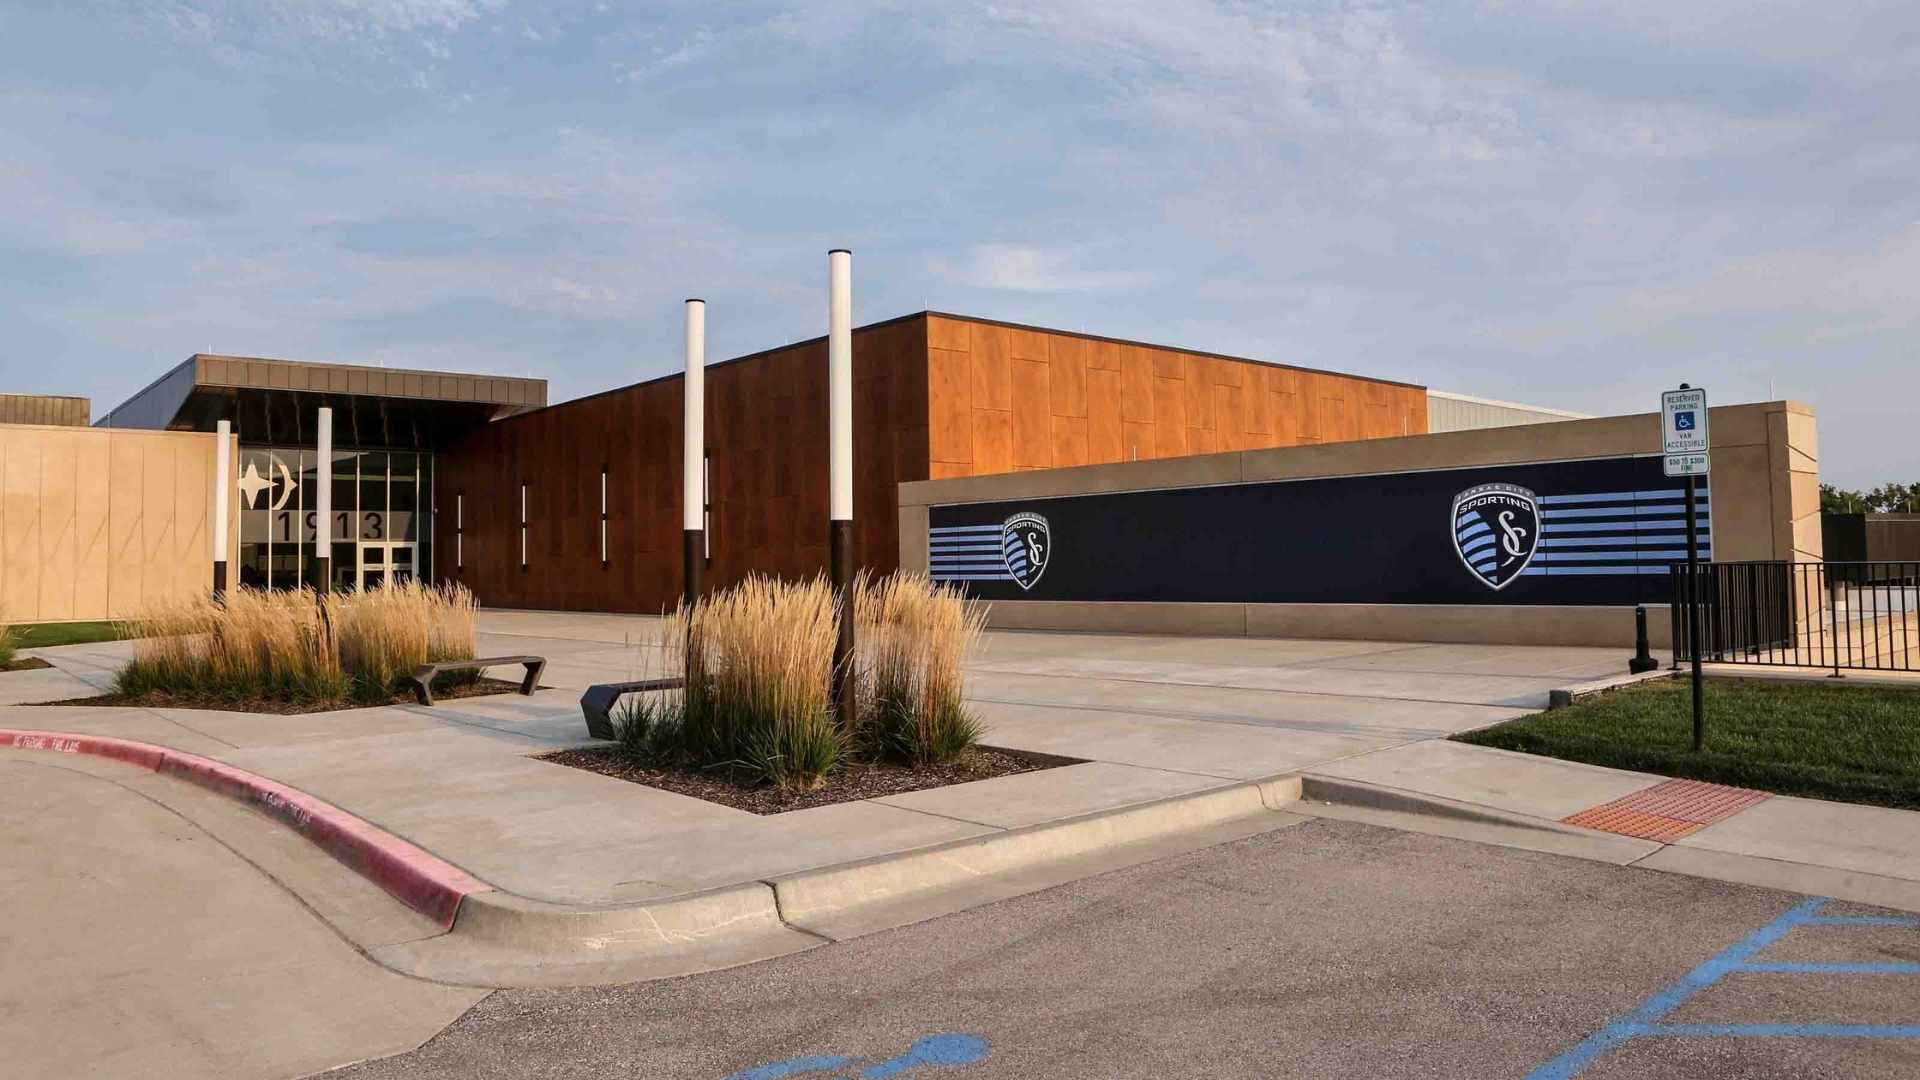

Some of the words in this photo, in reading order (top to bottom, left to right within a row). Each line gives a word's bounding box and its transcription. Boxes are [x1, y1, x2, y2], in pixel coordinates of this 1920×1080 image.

[1666, 394, 1700, 403] RESERVED
[1667, 440, 1705, 448] ACCESSIBLE
[1459, 496, 1531, 514] SPORTING
[1006, 521, 1046, 534] SPORTING
